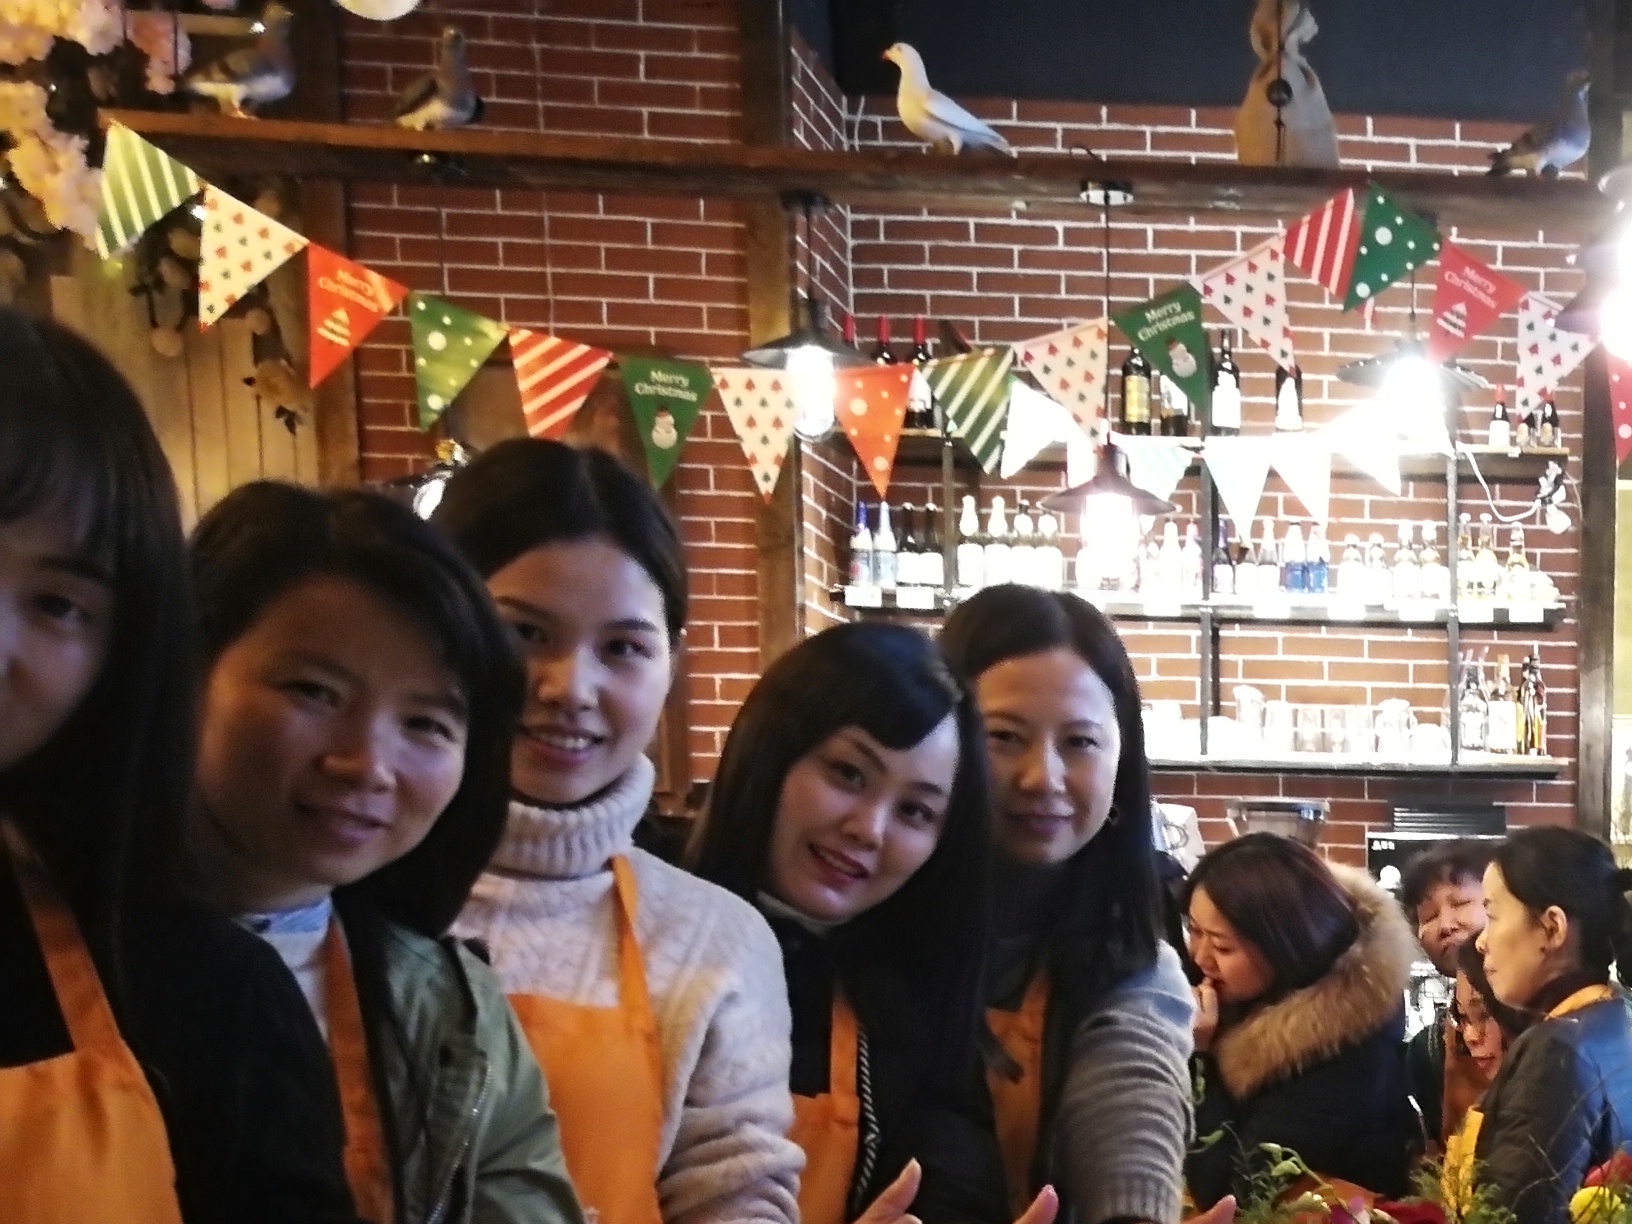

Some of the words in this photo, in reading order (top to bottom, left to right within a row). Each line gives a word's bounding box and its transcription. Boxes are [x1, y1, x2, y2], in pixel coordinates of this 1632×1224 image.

[337, 269, 375, 296] Merry
[1444, 270, 1497, 309] Christmas
[1463, 266, 1497, 294] Merry
[319, 277, 379, 312] Christmas
[1137, 311, 1195, 341] Christmas
[1144, 301, 1182, 324] Merry
[634, 382, 698, 402] Christmas
[650, 370, 689, 388] Merry
